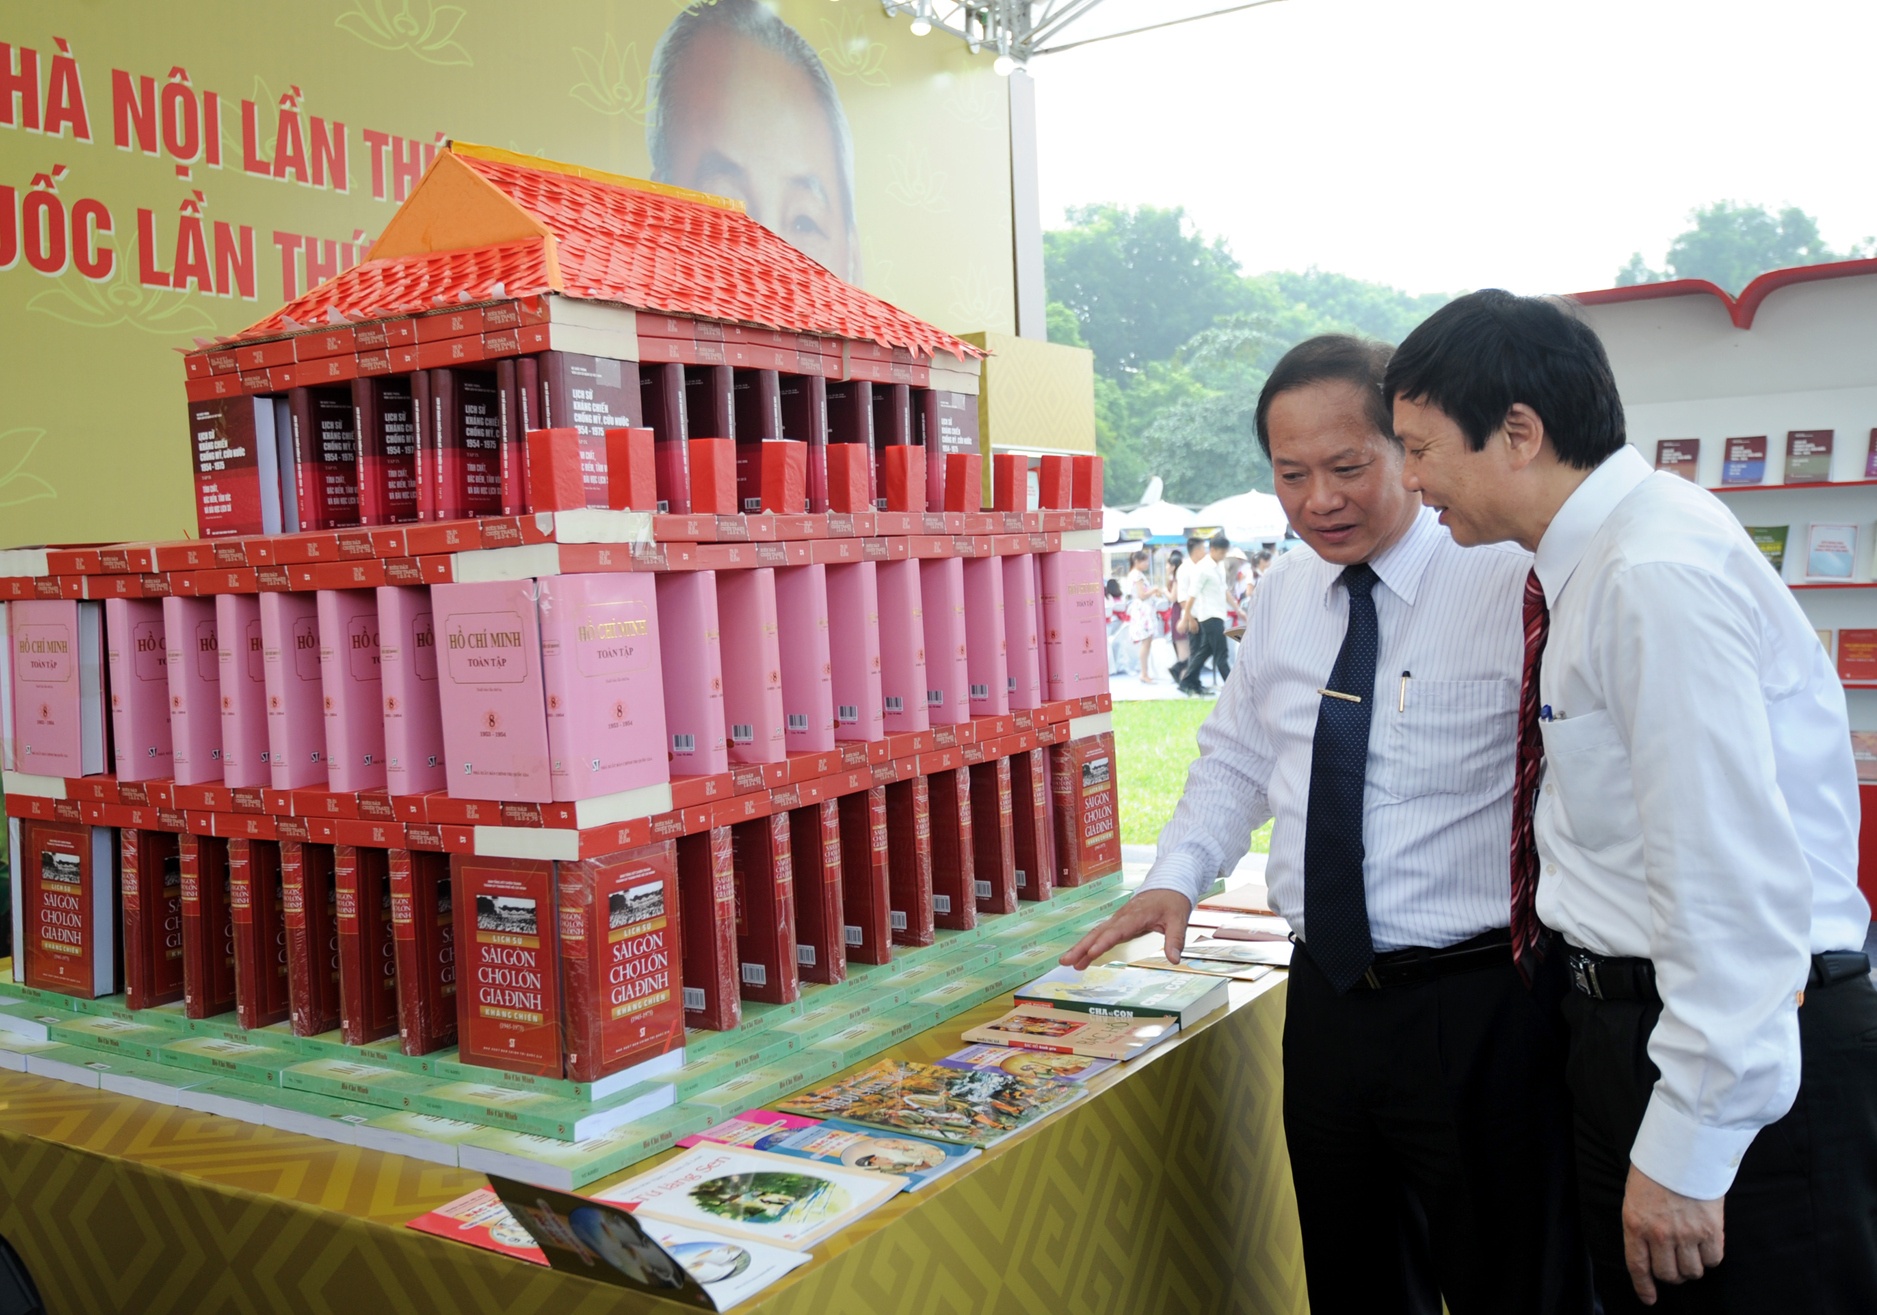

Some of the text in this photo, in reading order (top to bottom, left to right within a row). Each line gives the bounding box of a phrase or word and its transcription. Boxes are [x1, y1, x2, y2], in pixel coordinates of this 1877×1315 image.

[112, 66, 222, 180] NỘI
[242, 85, 349, 194] LẦN
[137, 190, 258, 301] LẦN
[572, 389, 585, 401] LỊCH
[384, 413, 397, 423] LỊCH
[465, 405, 478, 417] LỊCH
[321, 421, 334, 431] LỊCH
[465, 415, 484, 426] KHÁNG
[592, 426, 604, 436] 1975
[386, 446, 414, 455] 1954 197
[466, 439, 496, 449] 1954 1975
[324, 453, 338, 461] 1954
[578, 616, 647, 642] HỒ CHÍ MINH
[19, 634, 68, 654] HỒ CHÍ MINH
[137, 630, 156, 652] HỒ
[297, 627, 315, 649] HỒ
[352, 626, 371, 649] HỒ
[448, 625, 521, 649] HỒ CHÍ MINH
[597, 647, 634, 660] TOÀN TẬP
[30, 661, 57, 671] TOÀN TẬP
[467, 656, 507, 670] TOÀN TẬP
[616, 703, 623, 718] 8
[488, 713, 495, 727] 8
[622, 720, 634, 728] 1954
[148, 747, 157, 758] ST
[311, 752, 320, 763] ST
[364, 754, 373, 766] ST
[464, 762, 473, 775] ST
[44, 890, 79, 910] SÀI GÒN
[41, 909, 82, 928] CHỢ LỚN
[41, 926, 82, 945] GIA ĐỊNH
[613, 932, 664, 963] SÀI GÒN
[481, 944, 536, 968] SÀI GÒN
[610, 951, 668, 985] CHỢ LỚN
[478, 966, 541, 990] CHỢ LỚN
[611, 971, 669, 1005] GIA ĐỊNH
[479, 986, 542, 1010] GIA ĐỊNH
[1088, 1007, 1108, 1016] CHA
[1113, 1010, 1134, 1018] CON
